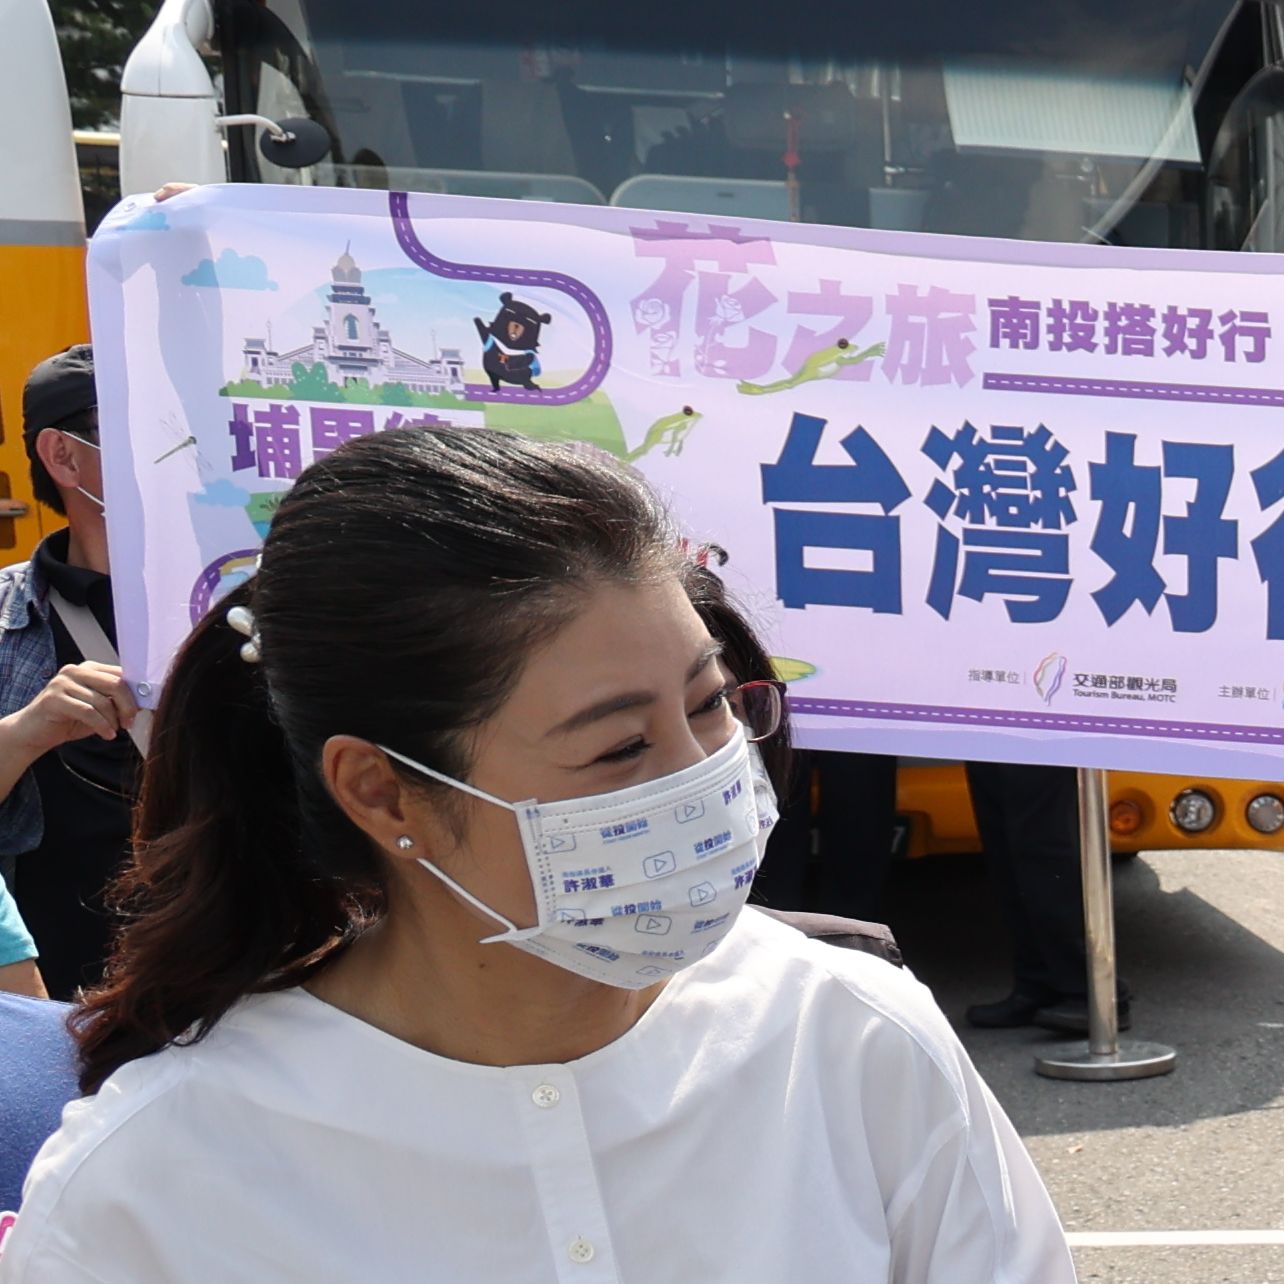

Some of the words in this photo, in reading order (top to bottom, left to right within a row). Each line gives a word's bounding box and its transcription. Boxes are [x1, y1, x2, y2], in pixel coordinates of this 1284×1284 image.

[628, 219, 978, 389] 花之旅
[229, 403, 452, 479] 埔里
[1072, 673, 1178, 693] 交通部觀光局
[1073, 688, 1109, 699] Tourism
[1148, 694, 1176, 703] MOTC
